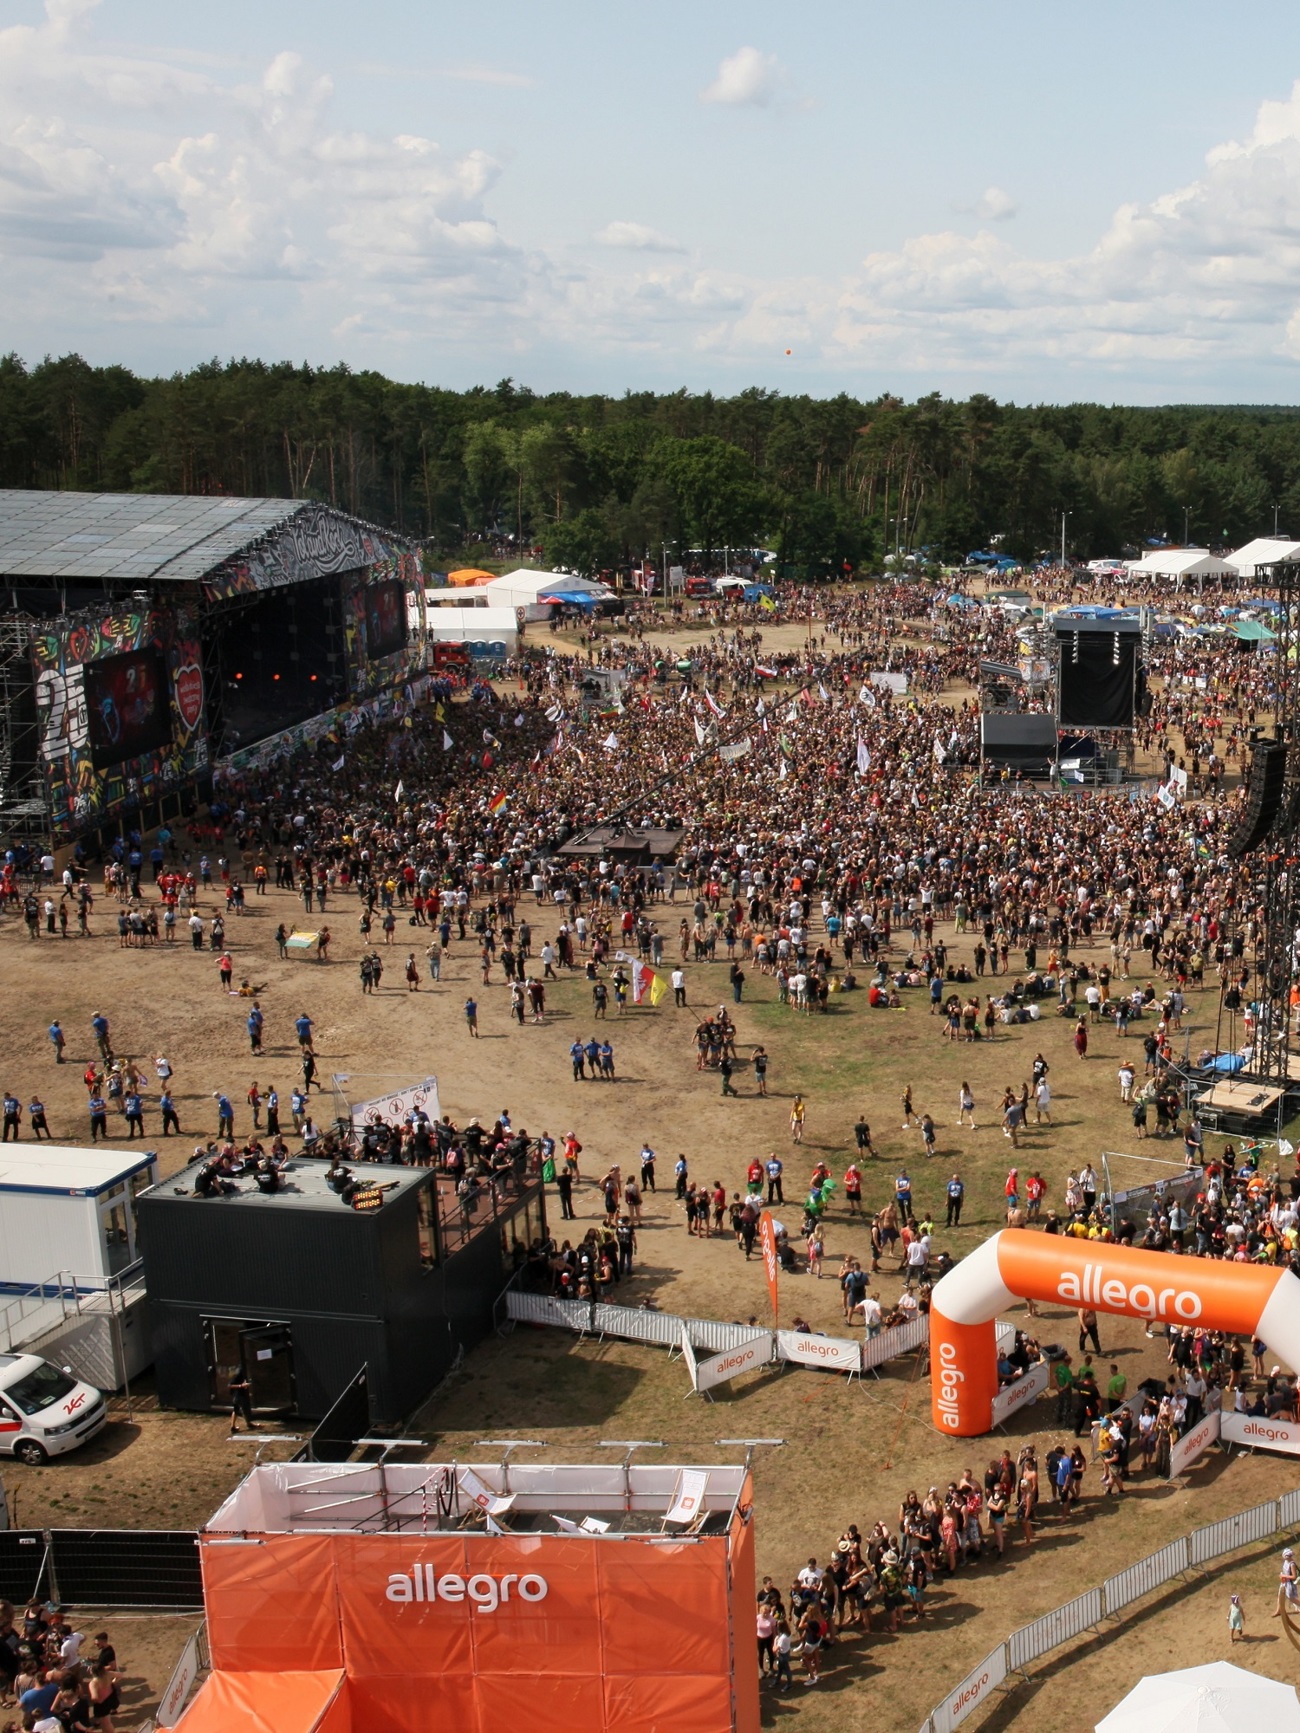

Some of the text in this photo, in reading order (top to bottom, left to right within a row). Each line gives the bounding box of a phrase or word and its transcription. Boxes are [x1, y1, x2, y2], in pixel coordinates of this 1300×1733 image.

[1057, 1264, 1202, 1319] allegro
[717, 1350, 754, 1373] allegro
[798, 1341, 839, 1357] allegro
[938, 1343, 965, 1428] allegro
[1007, 1380, 1035, 1406] allegro
[1184, 1427, 1209, 1456] allegro
[1243, 1423, 1289, 1441] allegro
[386, 1563, 549, 1614] allegro
[169, 1668, 188, 1715] allegro
[953, 1673, 989, 1715] allegro
